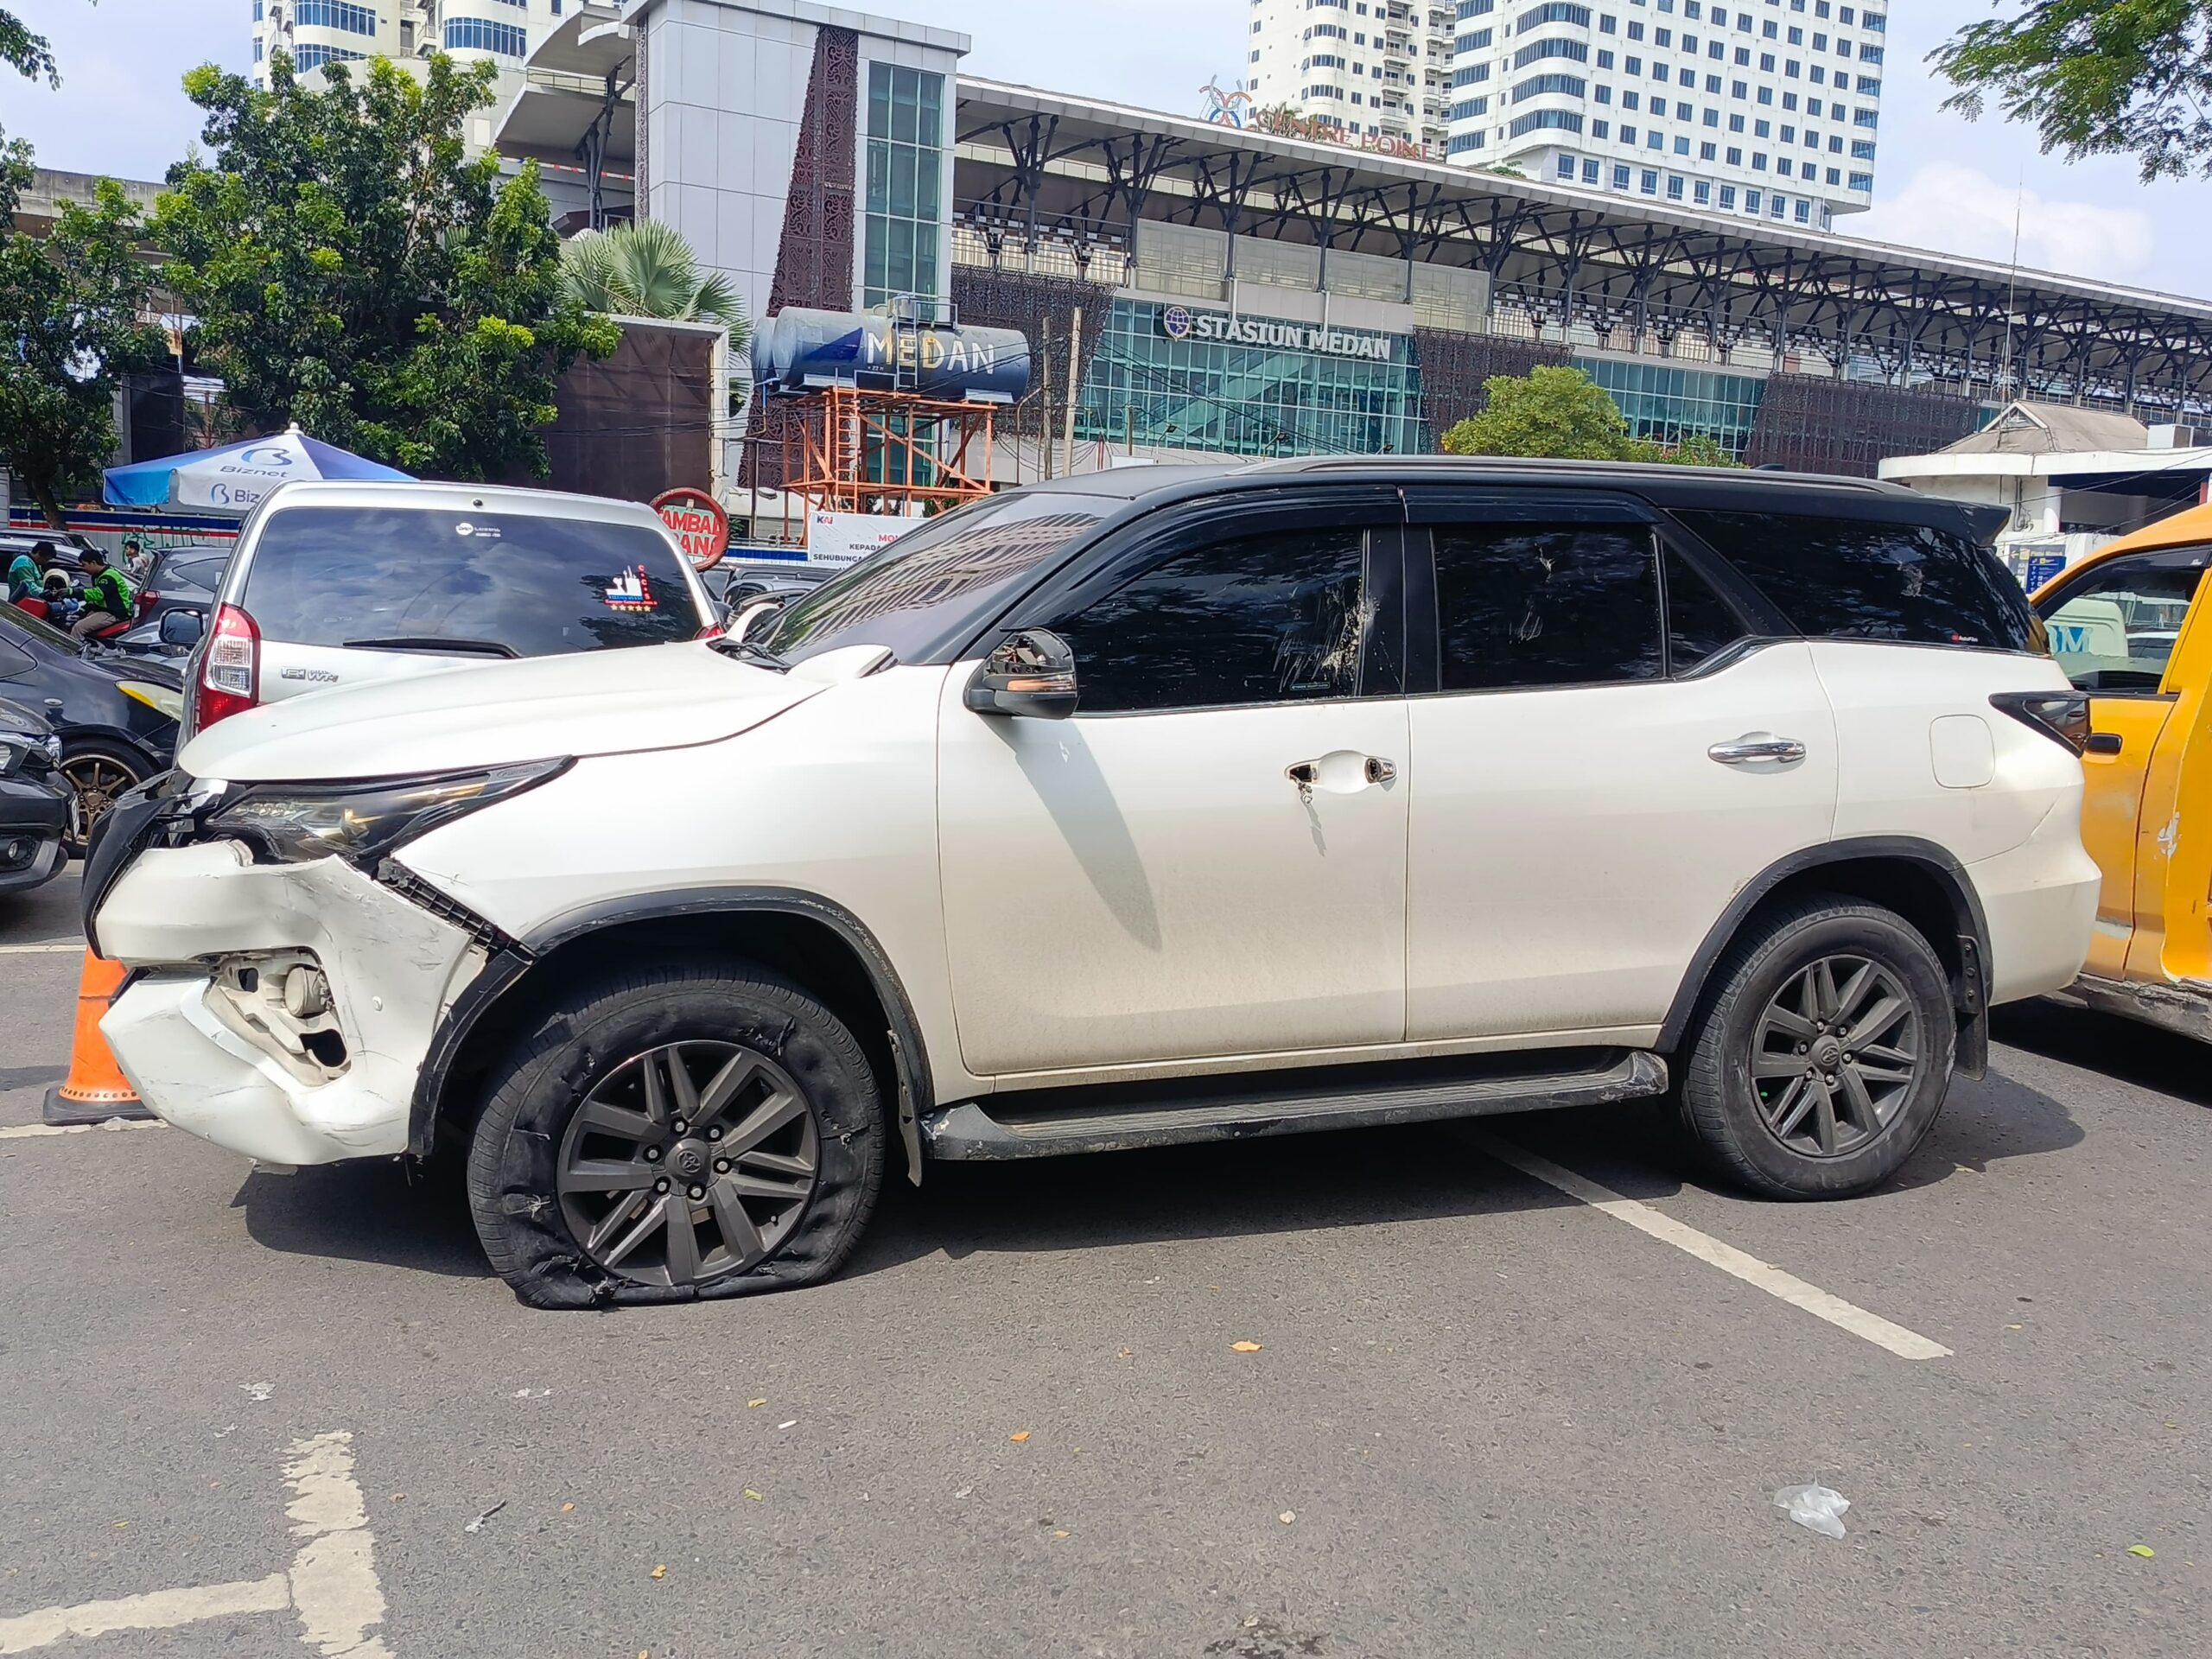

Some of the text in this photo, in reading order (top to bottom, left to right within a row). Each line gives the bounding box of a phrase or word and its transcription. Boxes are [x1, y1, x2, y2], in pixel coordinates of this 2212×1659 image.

[1361, 131, 1432, 160] POINT
[1196, 314, 1391, 359] STASIUN MEDAN
[867, 328, 994, 374] MEDAN
[219, 466, 289, 478] Biznet
[659, 509, 720, 535] AMBAL
[675, 533, 709, 556] AN
[878, 534, 899, 543] MO
